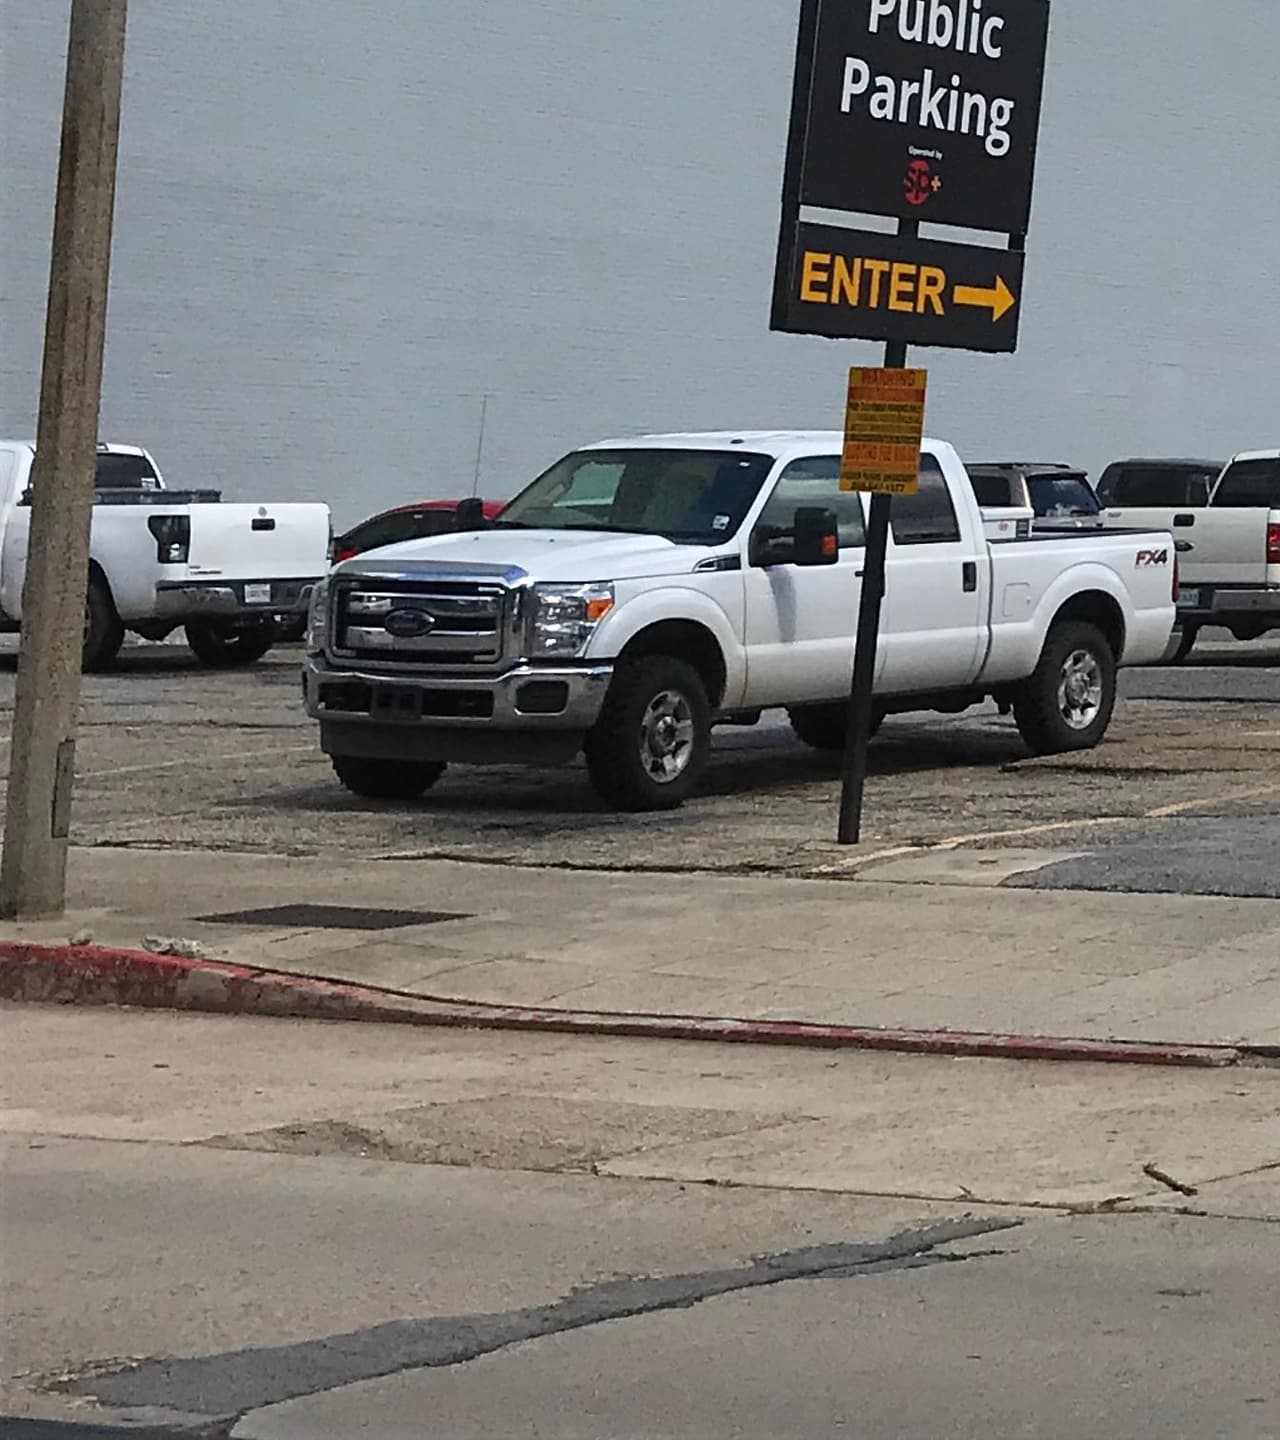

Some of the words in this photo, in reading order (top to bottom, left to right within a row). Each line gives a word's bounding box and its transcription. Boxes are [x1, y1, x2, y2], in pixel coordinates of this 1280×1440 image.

[840, 56, 1014, 156] Parking
[800, 251, 946, 315] ENTER
[1136, 549, 1167, 565] FX4
